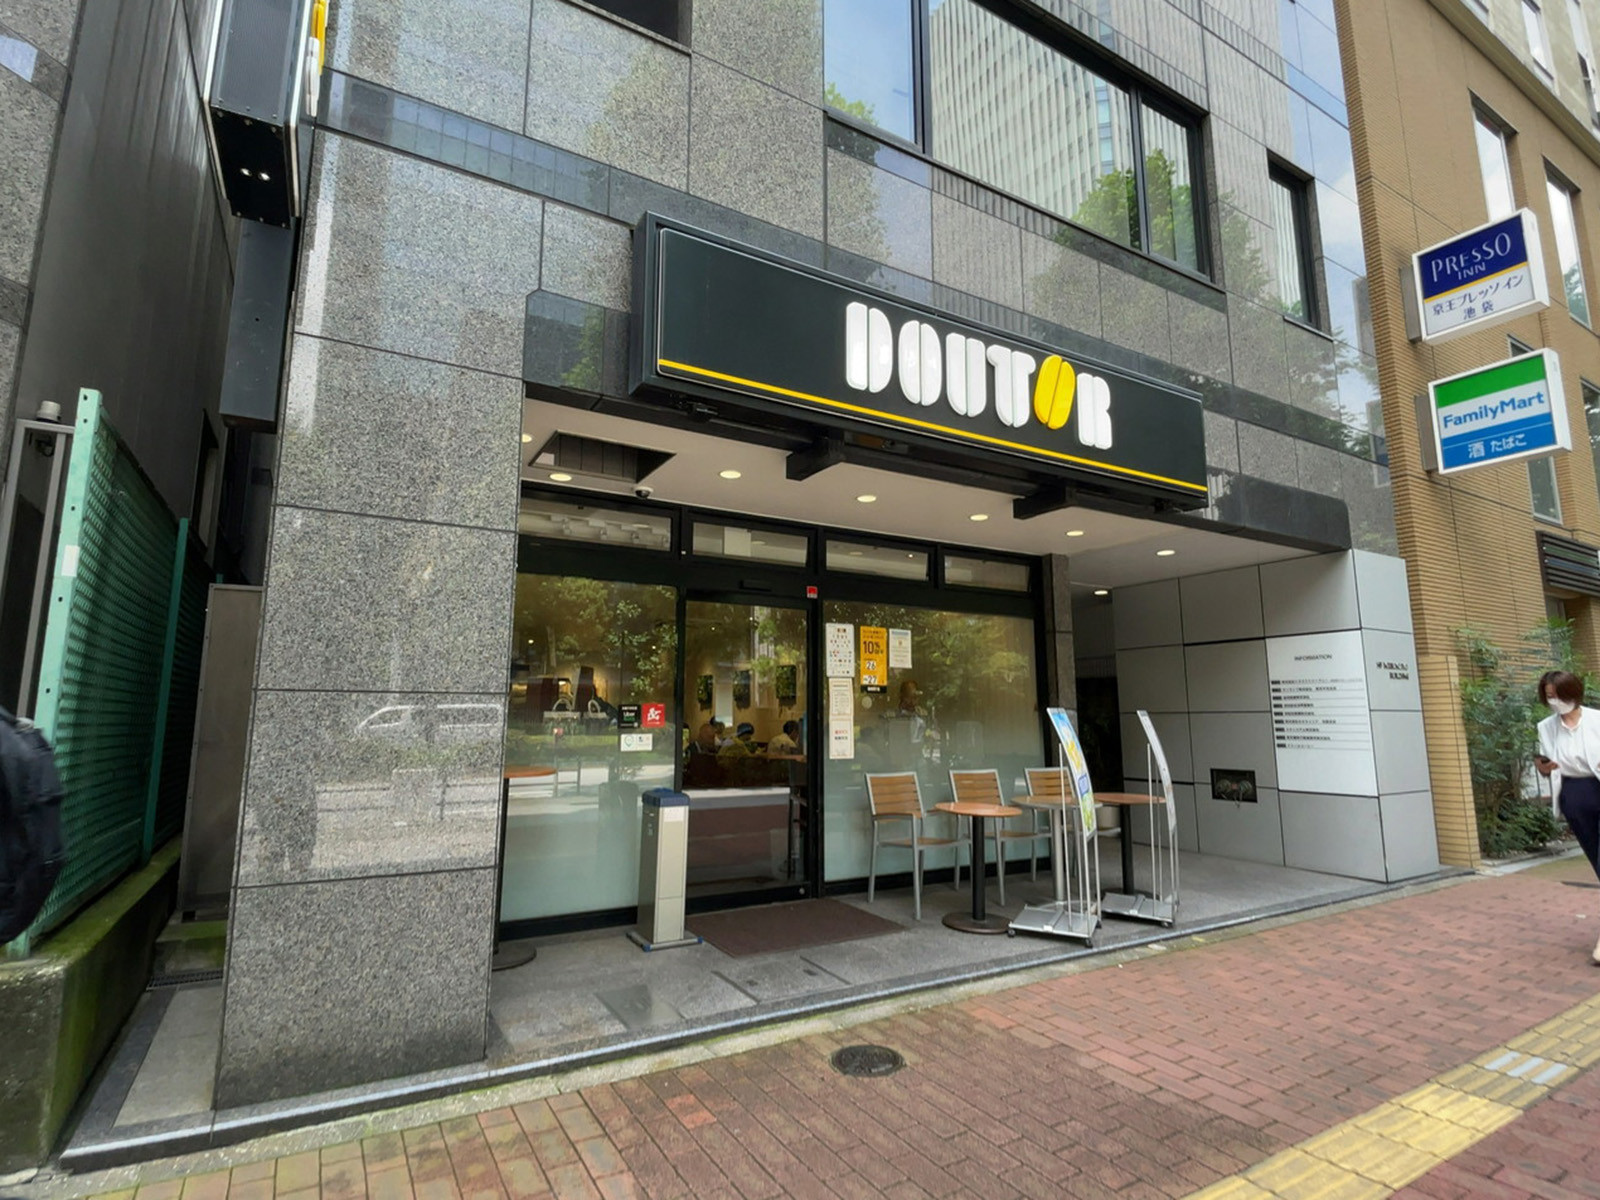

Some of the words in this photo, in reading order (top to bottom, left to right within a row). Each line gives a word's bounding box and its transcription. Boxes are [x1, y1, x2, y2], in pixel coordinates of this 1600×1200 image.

[1431, 232, 1511, 282] PRESSO
[1458, 261, 1487, 281] INN
[1463, 301, 1494, 320] 池袋
[846, 301, 1112, 450] DOUTOR
[1443, 391, 1545, 429] FamilyMart
[1468, 441, 1485, 459] 酒
[1490, 433, 1527, 453] たばこ
